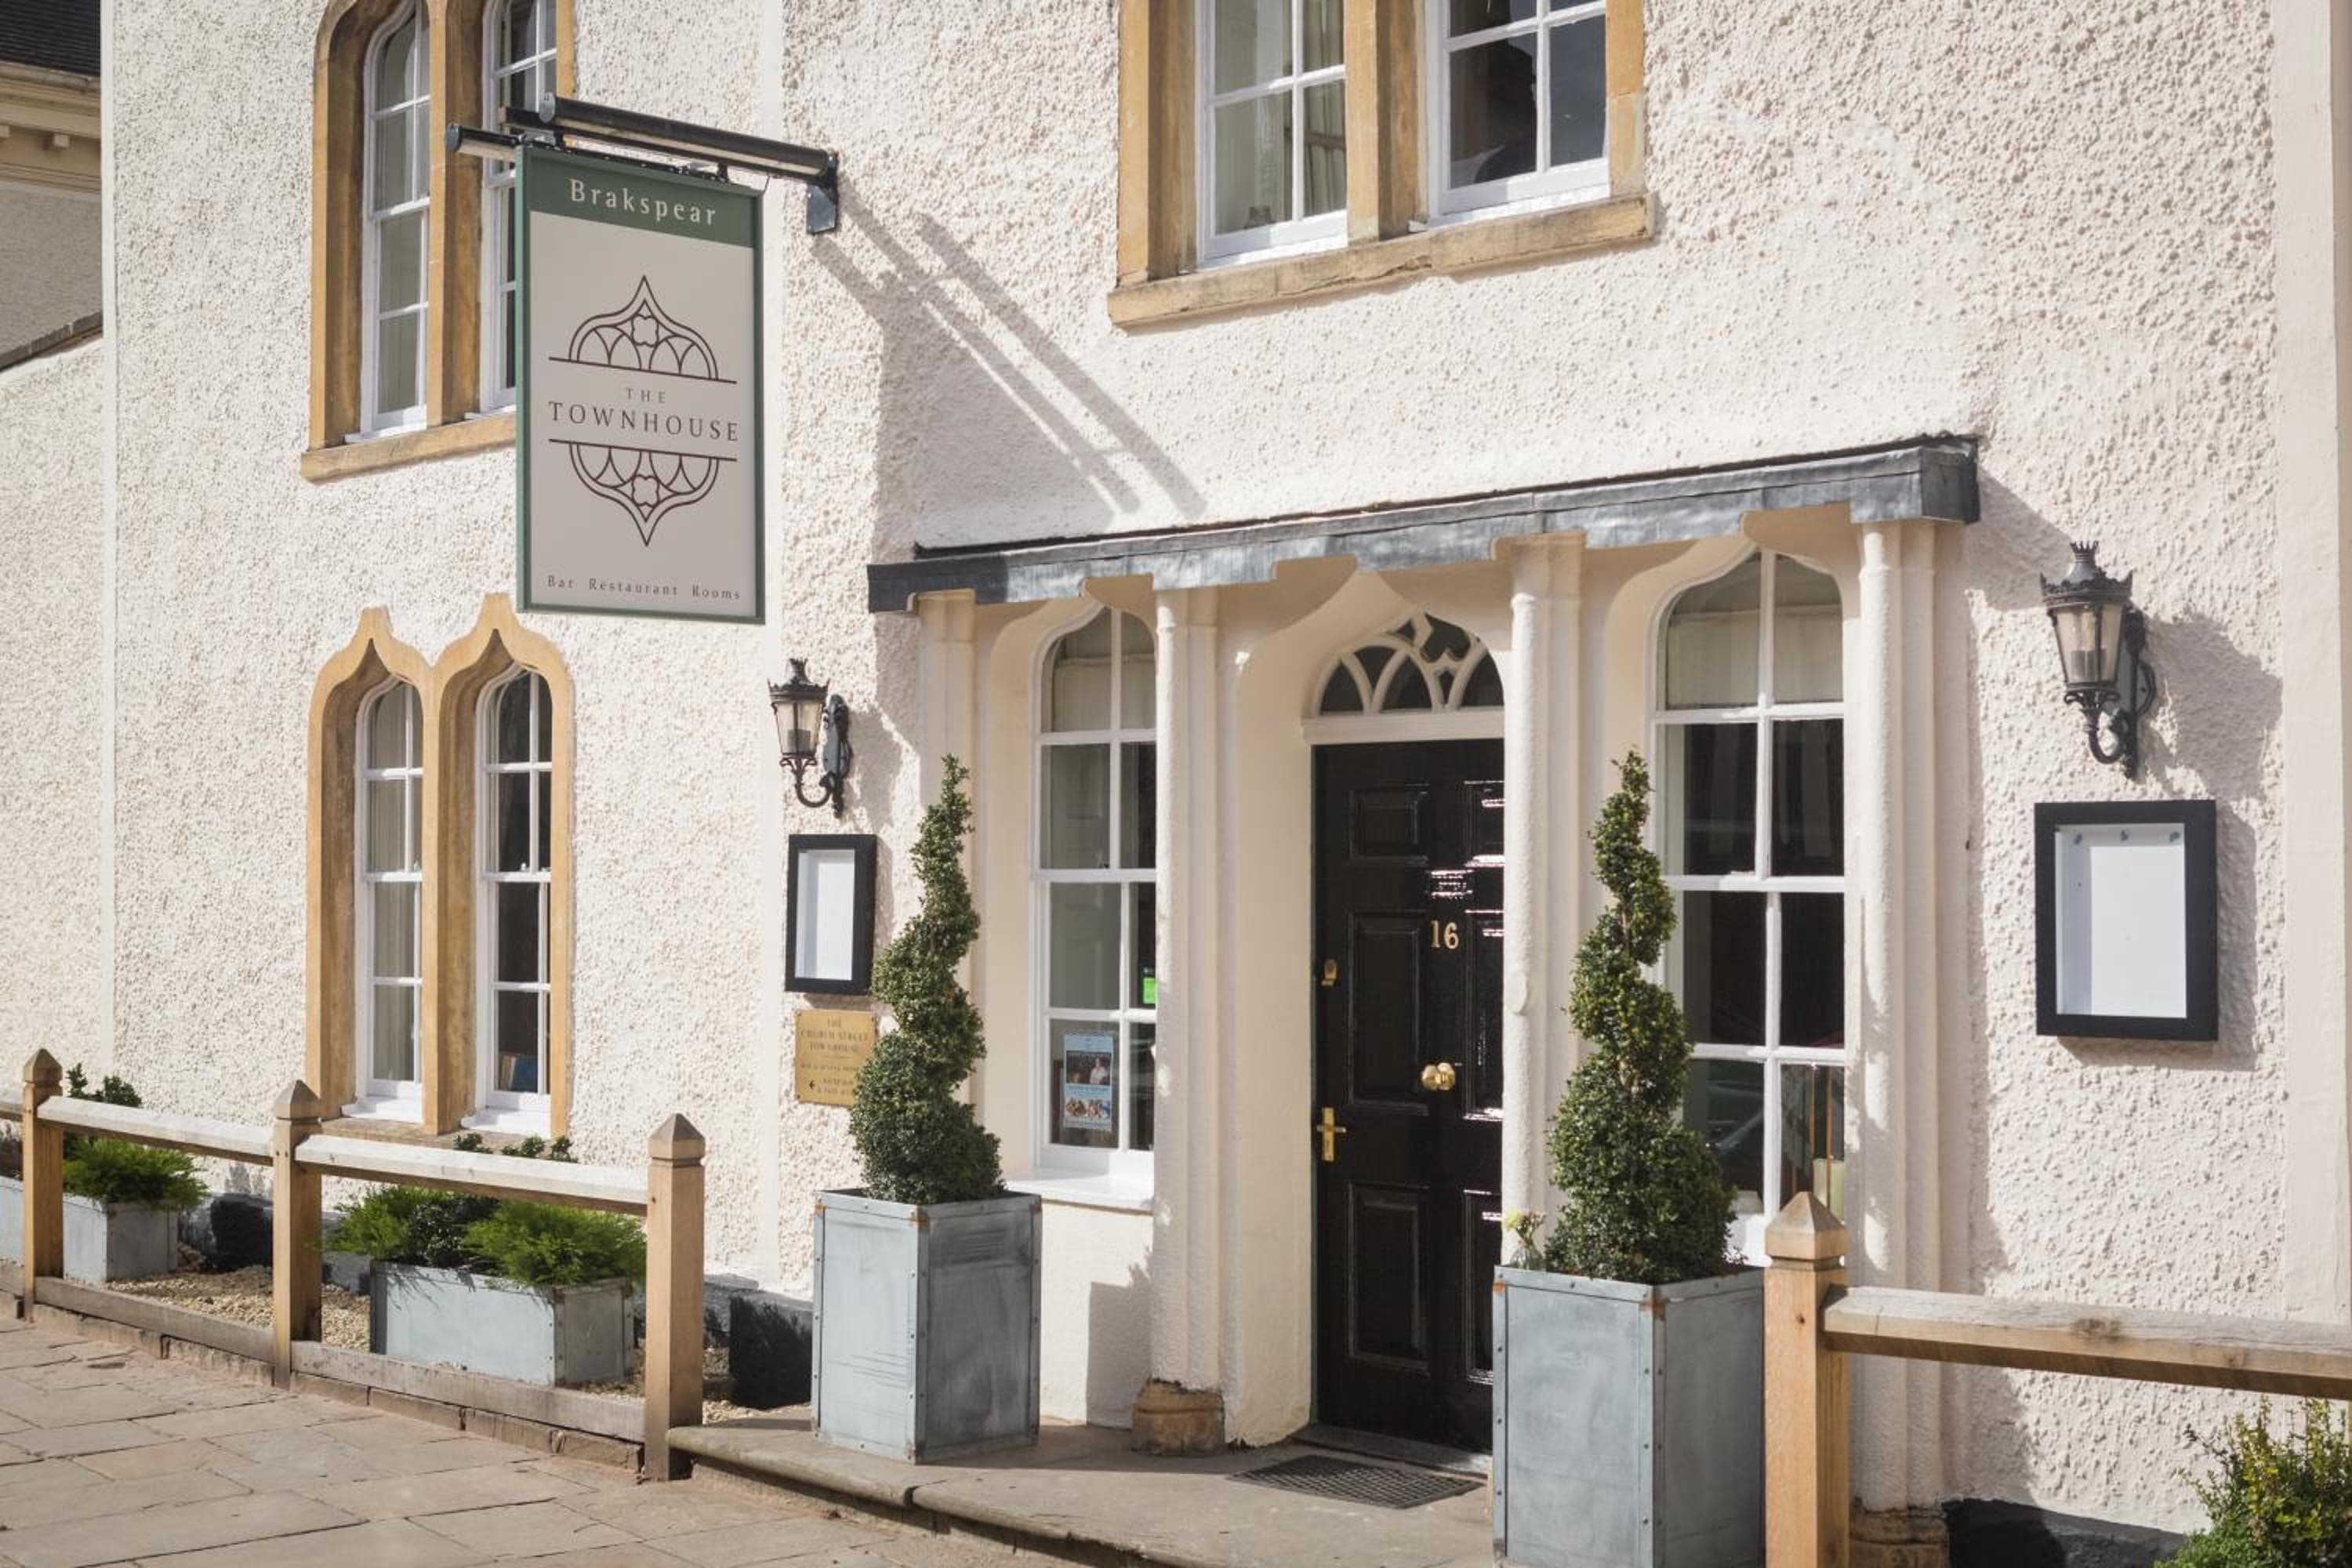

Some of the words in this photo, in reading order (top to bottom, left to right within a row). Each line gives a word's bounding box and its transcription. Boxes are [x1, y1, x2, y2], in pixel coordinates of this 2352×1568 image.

[569, 178, 716, 225] Brakspear
[626, 387, 666, 404] THE
[549, 401, 739, 441] TOWNHOUSE
[547, 575, 575, 589] Bar
[589, 577, 677, 596] Restaurant
[692, 584, 741, 601] Rooms
[1430, 920, 1459, 949] 16
